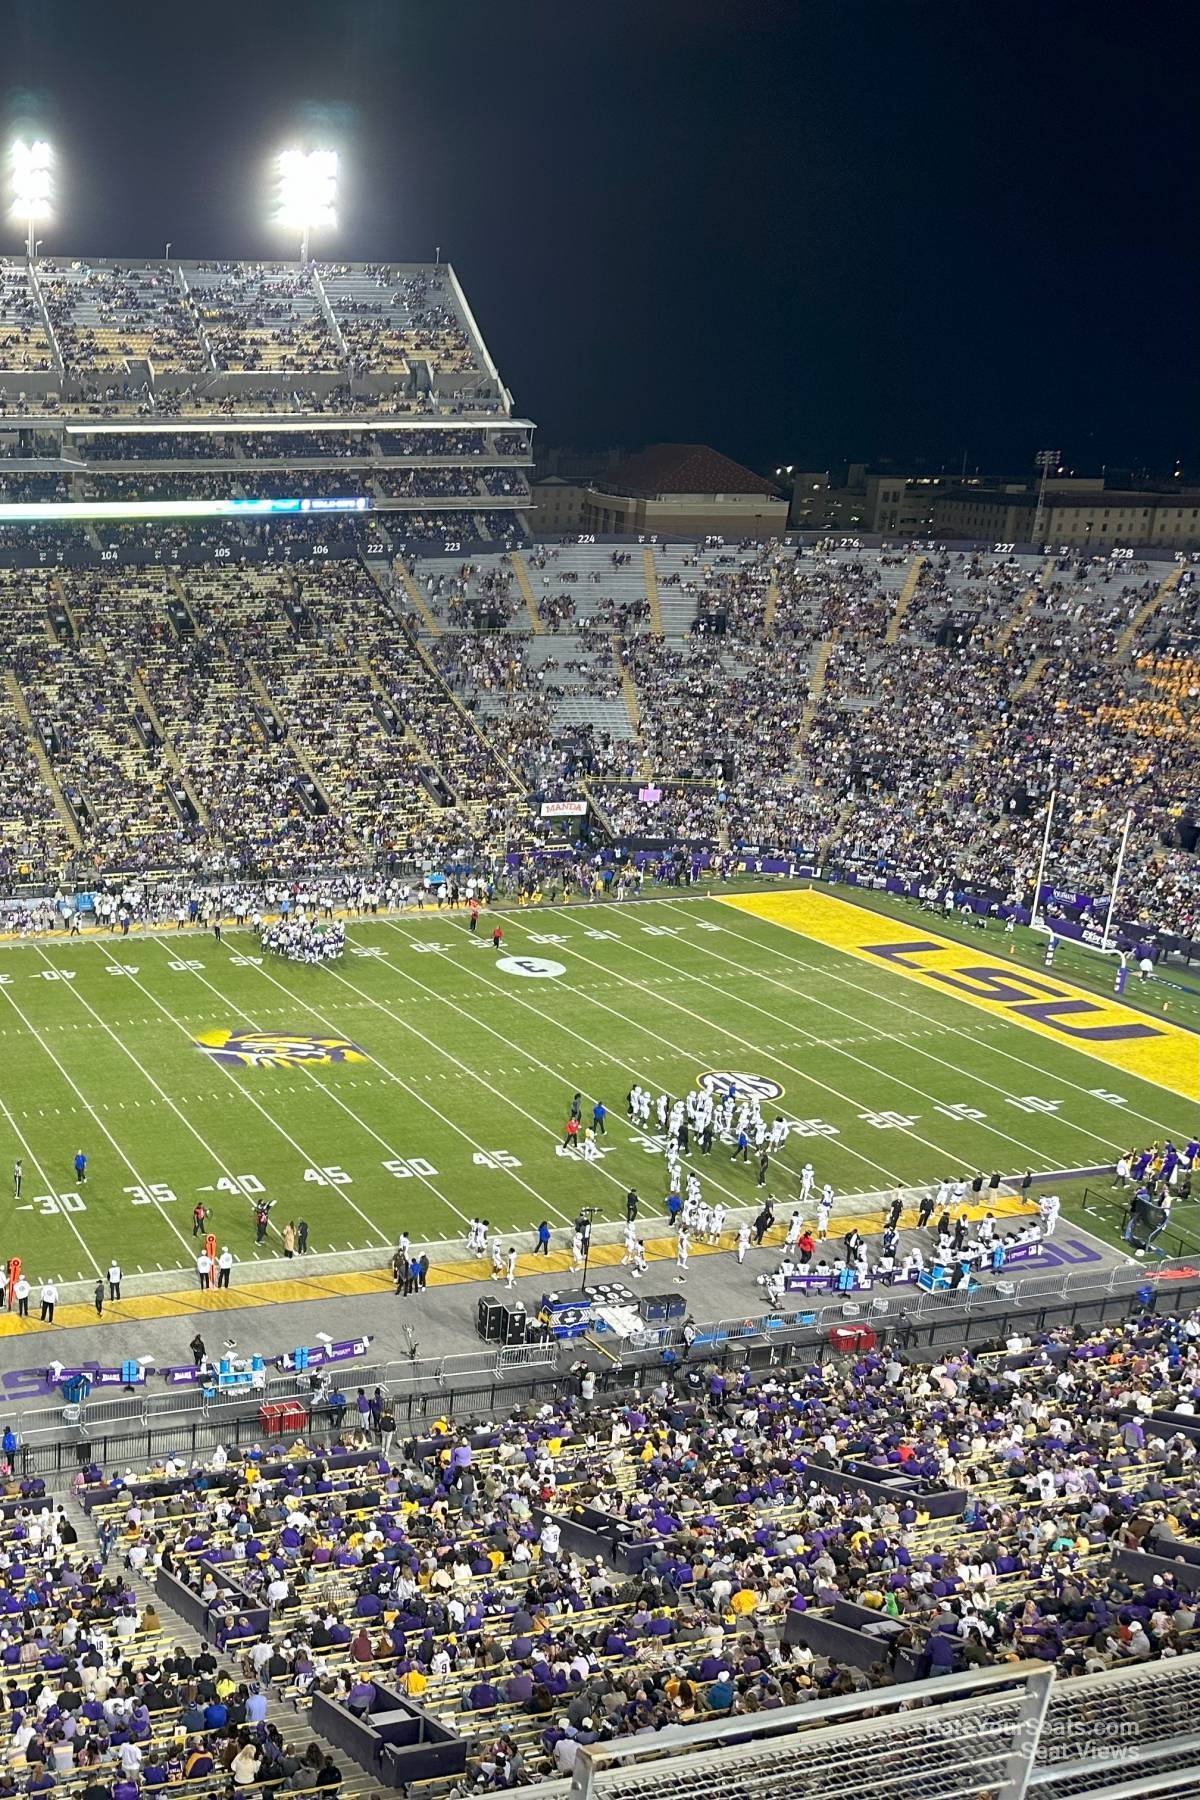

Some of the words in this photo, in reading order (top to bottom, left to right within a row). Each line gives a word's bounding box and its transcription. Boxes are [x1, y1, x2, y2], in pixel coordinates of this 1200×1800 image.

[577, 535, 595, 544] 224
[214, 548, 231, 557] 105
[312, 545, 329, 554] 106
[367, 544, 384, 553] 222
[444, 543, 461, 552] 223
[993, 543, 1015, 553] 227
[101, 551, 118, 560] 104
[1111, 548, 1134, 558] 228
[546, 803, 582, 813] MANDA
[641, 926, 676, 936] 10
[696, 922, 719, 932] 5
[527, 934, 568, 945] 20
[584, 930, 622, 940] 15
[350, 947, 389, 957] 35
[409, 943, 450, 953] 30
[168, 960, 206, 971] 50
[229, 956, 263, 966] 45
[41, 970, 77, 981] 40
[105, 965, 140, 976] 45
[858, 941, 1168, 1042] LSU
[1089, 1088, 1128, 1104] 5
[1005, 1096, 1059, 1113] 10
[933, 1104, 987, 1121] 15
[857, 1111, 915, 1129] 20
[472, 1150, 523, 1168] 45
[381, 1158, 439, 1177] 50
[303, 1166, 353, 1185] 45
[216, 1174, 266, 1195] 40
[123, 1183, 177, 1205] 35
[34, 1192, 87, 1215] 30
[441, 1663, 447, 1673] 9
